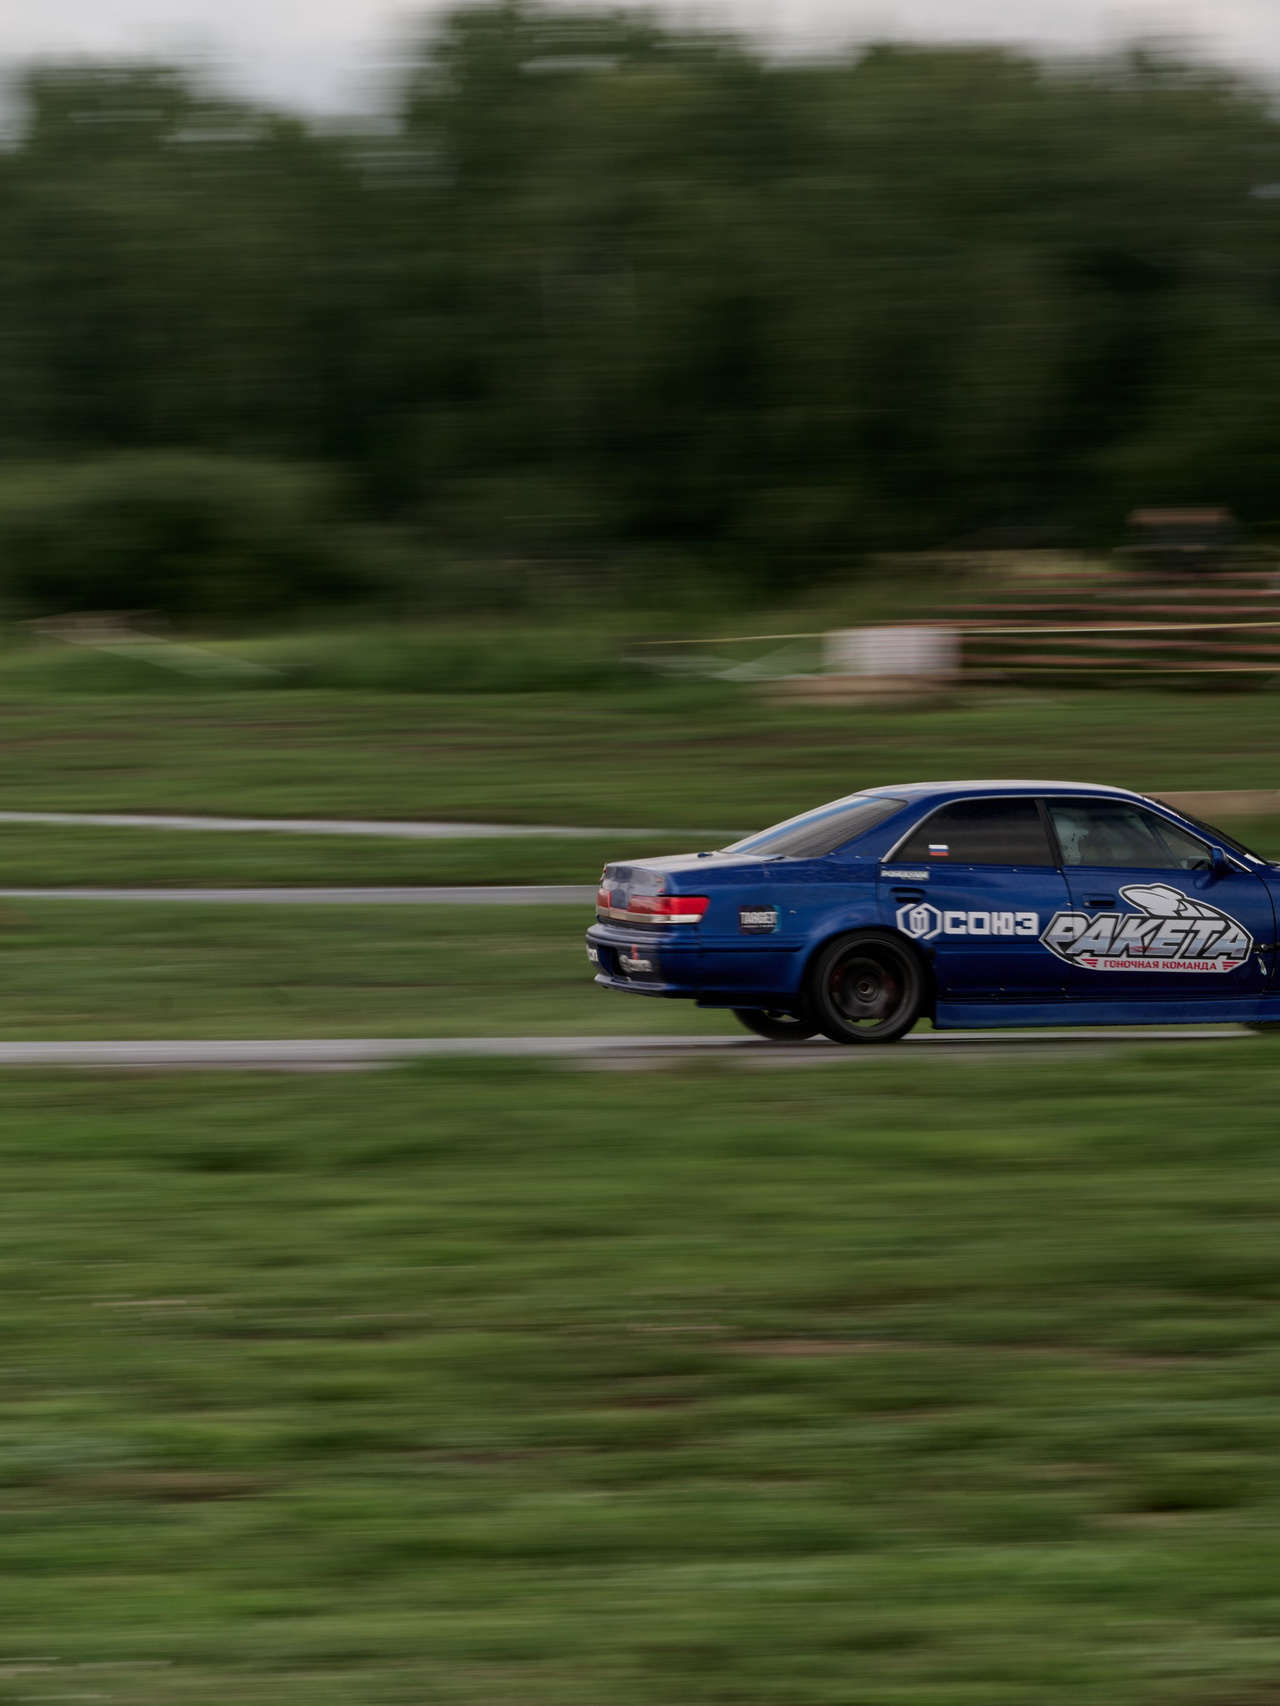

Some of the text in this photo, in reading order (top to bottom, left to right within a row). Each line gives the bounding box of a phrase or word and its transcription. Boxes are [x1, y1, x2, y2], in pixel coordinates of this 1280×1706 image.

[739, 911, 778, 924] TARGET
[943, 911, 1039, 935] СОЮЗ
[1048, 912, 1248, 959] РАКЕТА
[1103, 959, 1218, 970] ГОНОЧНАЯ КОМАНДА
